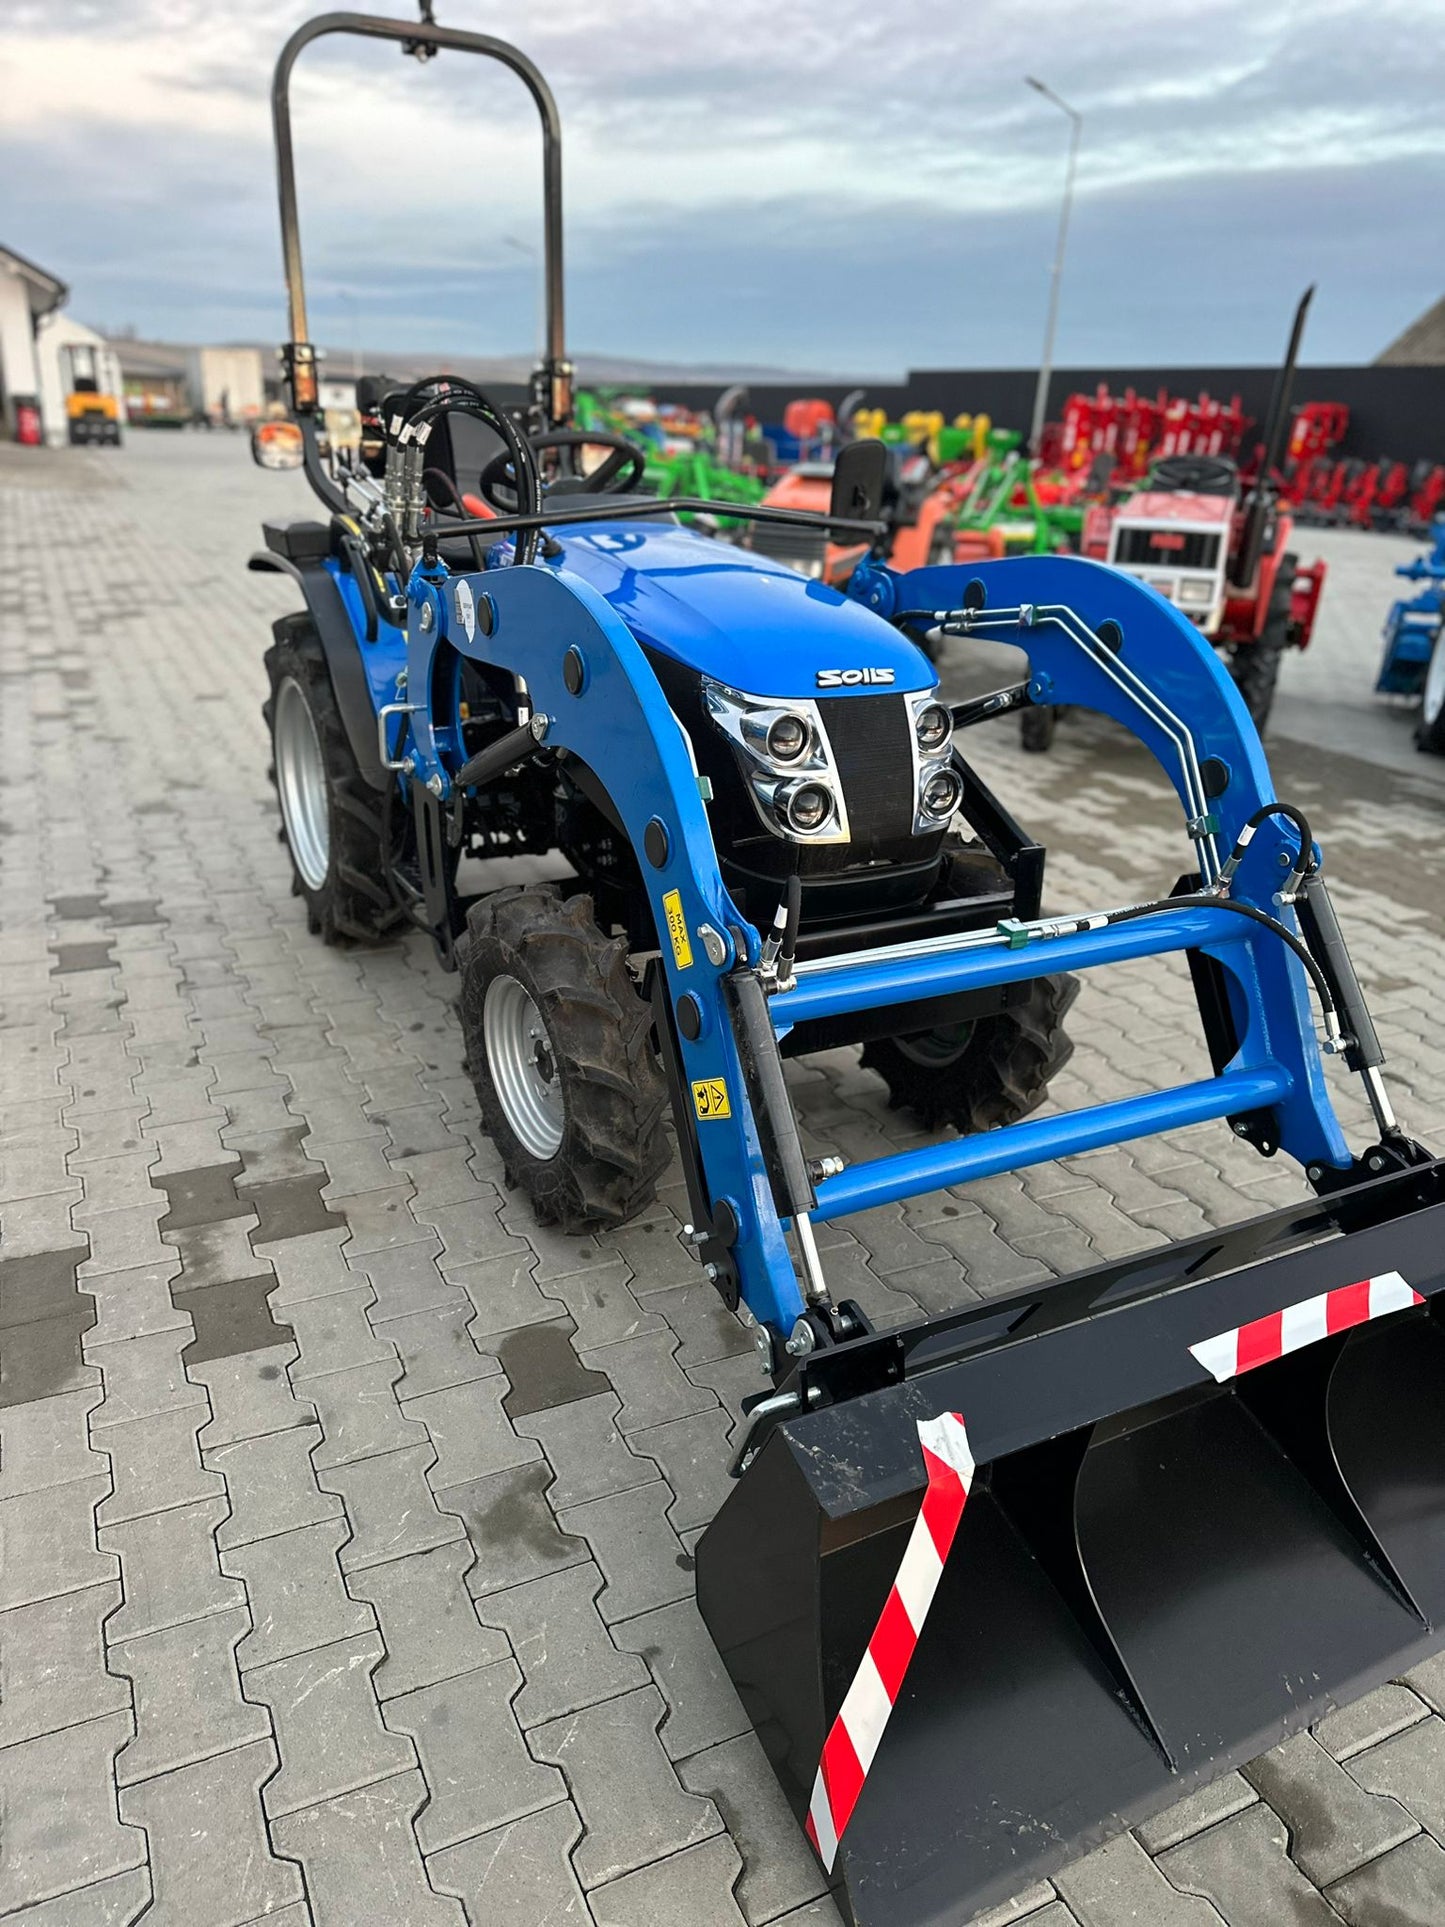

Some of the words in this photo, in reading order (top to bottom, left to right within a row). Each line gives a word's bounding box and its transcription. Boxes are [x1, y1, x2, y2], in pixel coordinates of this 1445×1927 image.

[668, 907, 677, 932] 300
[674, 936, 682, 956] KG
[676, 913, 686, 943] MAX
